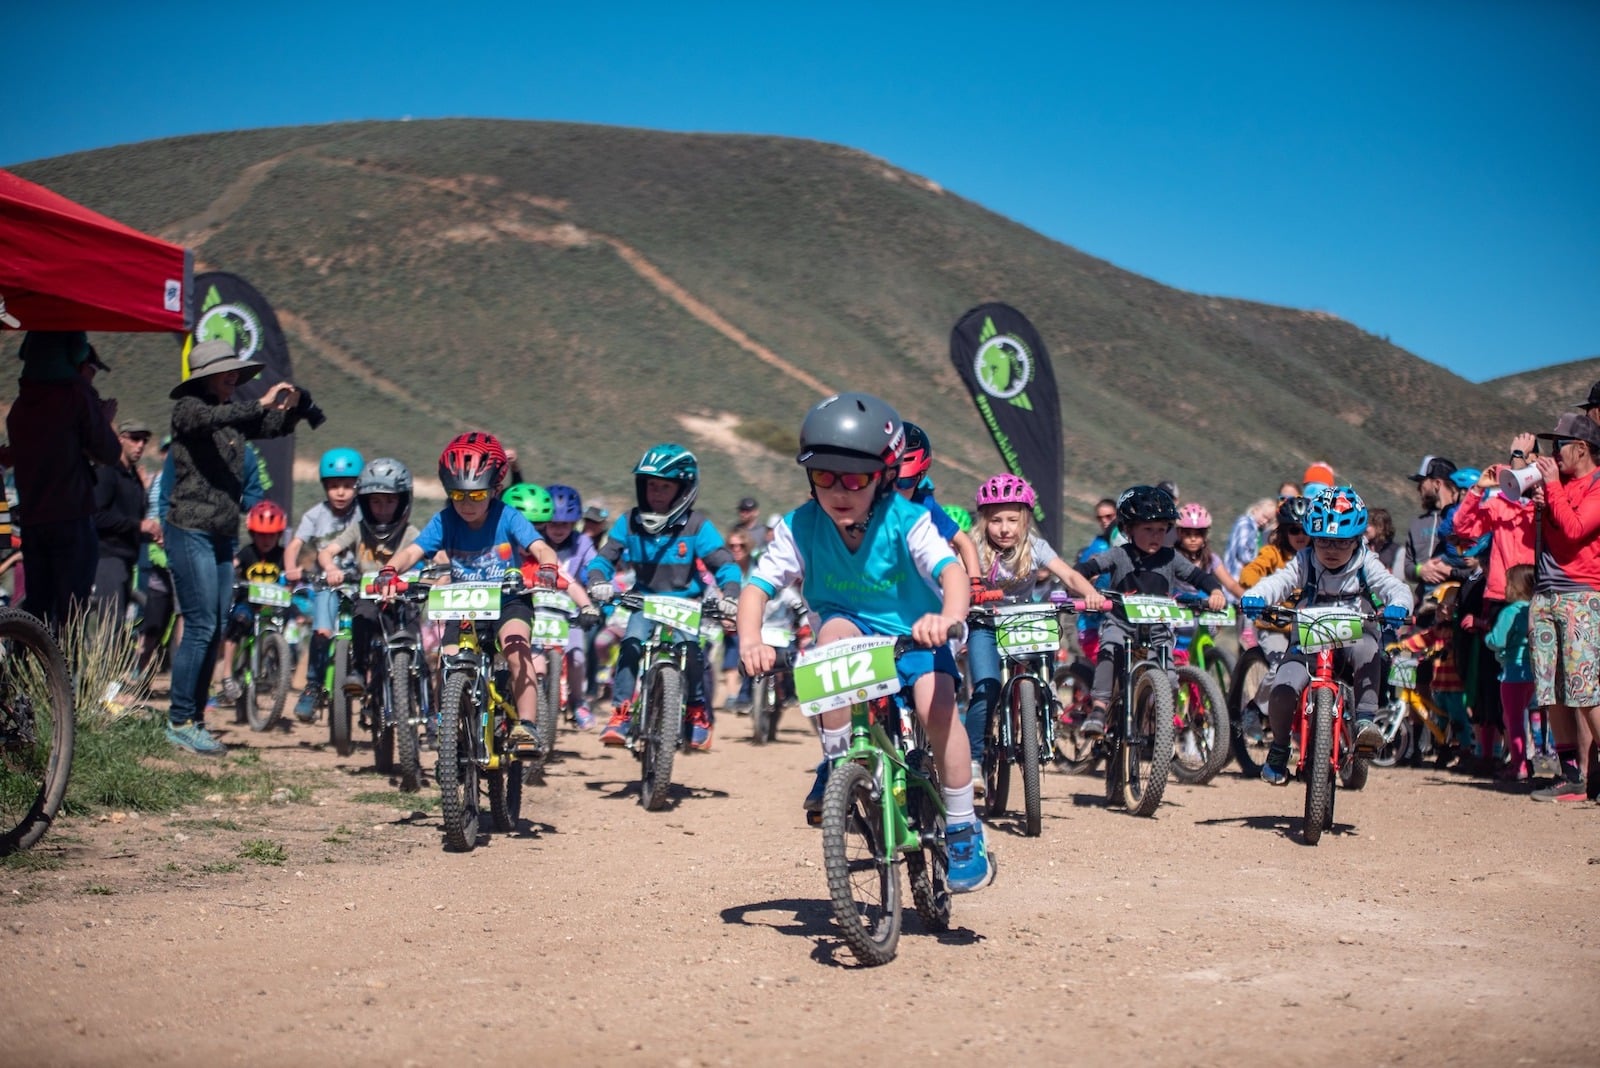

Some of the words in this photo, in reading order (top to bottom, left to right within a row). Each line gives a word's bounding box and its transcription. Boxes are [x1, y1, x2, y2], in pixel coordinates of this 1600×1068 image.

[485, 562, 510, 580] Uta
[440, 589, 490, 609] 120
[652, 603, 693, 623] 107
[1136, 604, 1171, 617] 101
[851, 640, 892, 652] GROWLER
[815, 652, 876, 693] 112
